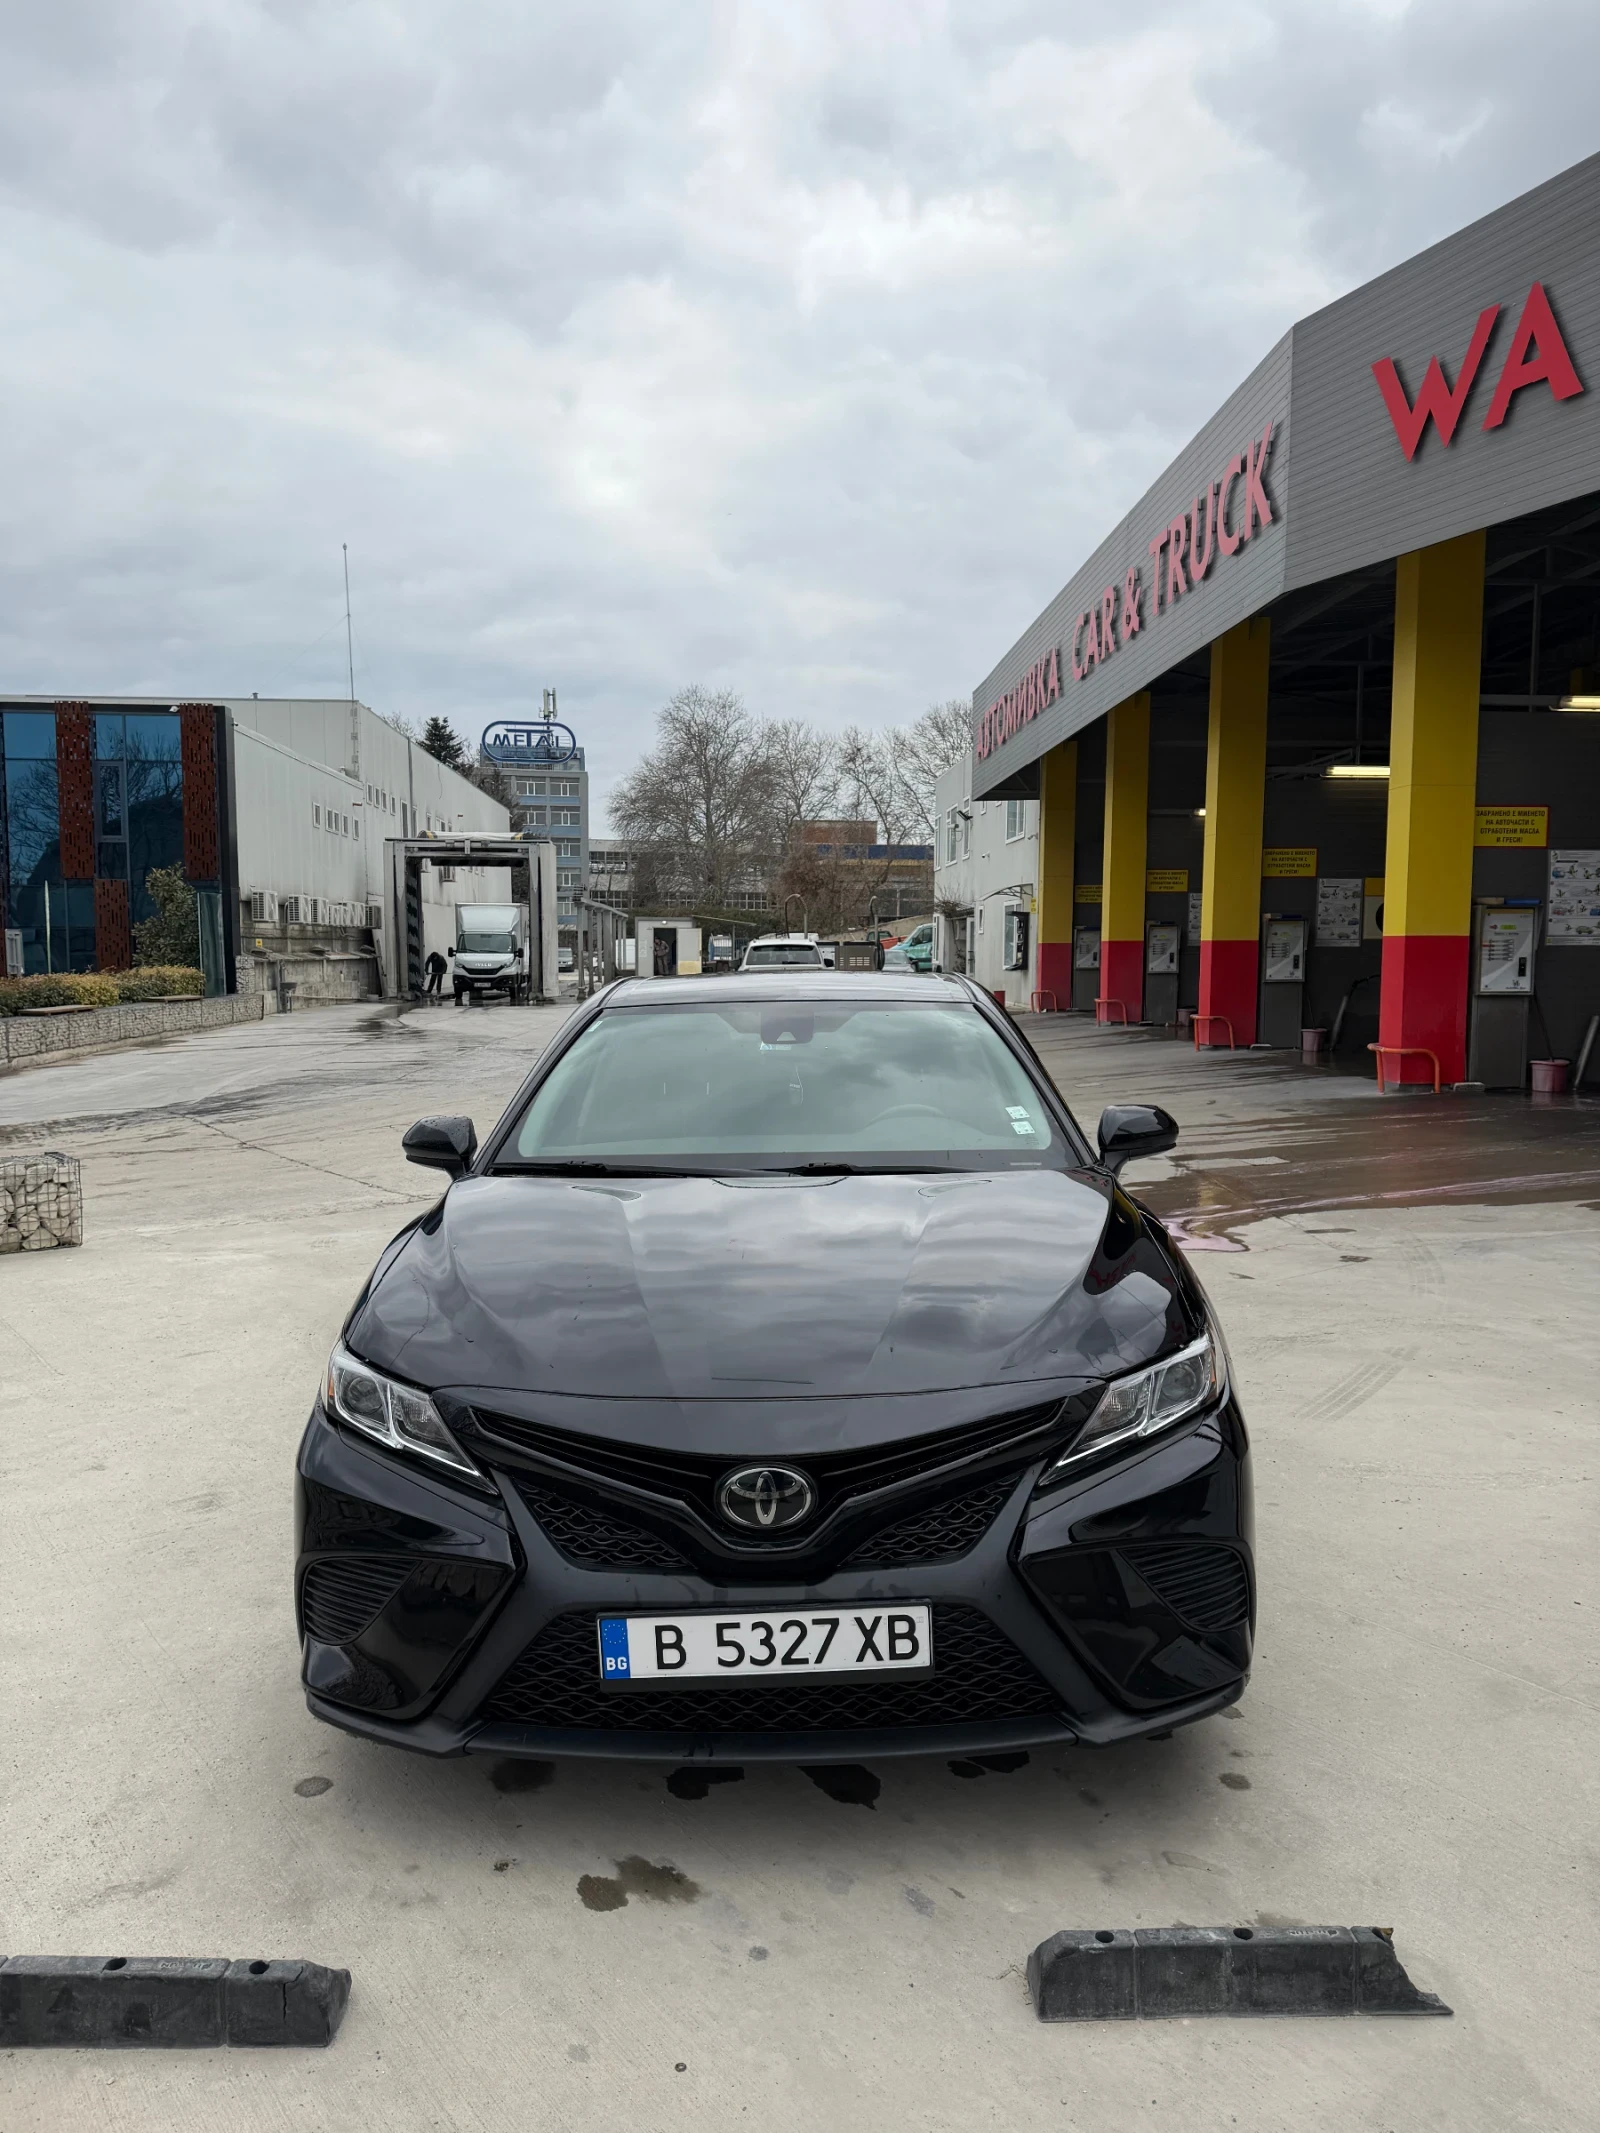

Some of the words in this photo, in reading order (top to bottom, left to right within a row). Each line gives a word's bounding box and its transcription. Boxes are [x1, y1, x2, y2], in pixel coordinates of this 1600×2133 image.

[1371, 280, 1584, 463] WA
[977, 647, 1059, 764] АВТОМИВКА
[1071, 585, 1115, 681] CAR
[1121, 567, 1141, 641] &
[1149, 419, 1274, 616] TRUCK
[606, 1657, 627, 1671] BG
[654, 1624, 687, 1670] B
[715, 1617, 840, 1668] 5327
[853, 1614, 920, 1663] XB
